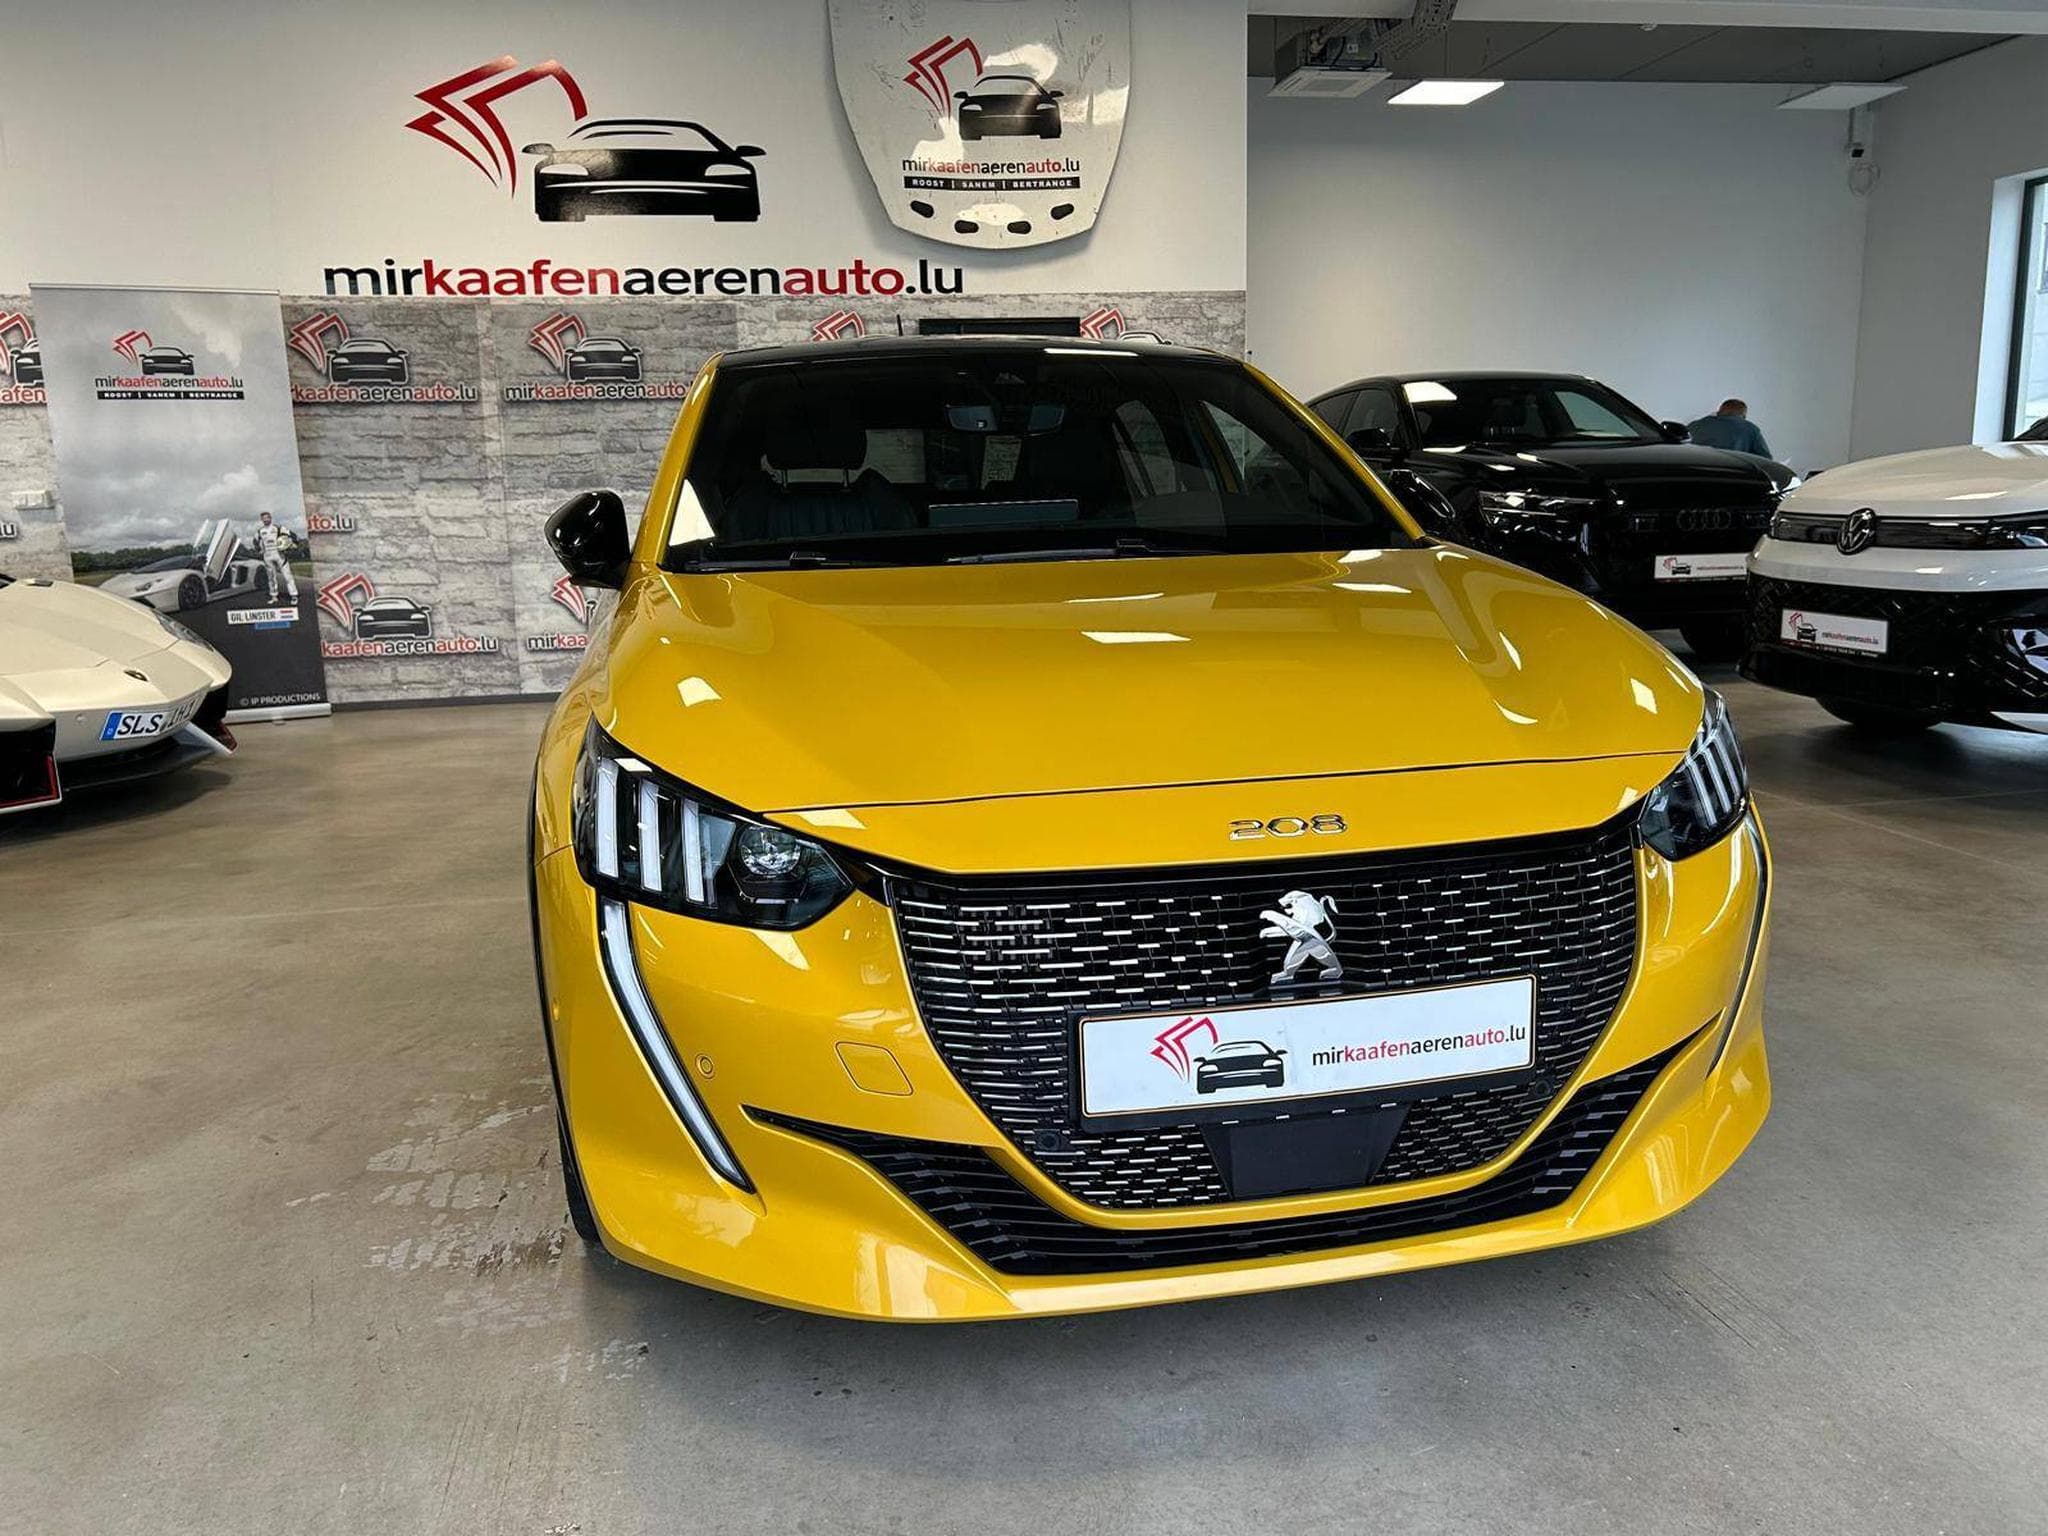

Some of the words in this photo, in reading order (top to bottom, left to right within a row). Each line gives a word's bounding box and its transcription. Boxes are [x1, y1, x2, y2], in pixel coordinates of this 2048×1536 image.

[902, 157, 1080, 175] mirkaafenaerenauto.lu
[912, 179, 945, 188] ROOST
[962, 181, 996, 189] SANEM
[1012, 179, 1073, 188] BERTRANGE
[324, 258, 964, 297] mirkaafenaerenauto.lu
[95, 375, 244, 389] mirkaafenaerenauto.lu
[290, 383, 477, 401] kaafenaerenauto.lu
[1229, 814, 1348, 841] 208
[1312, 1025, 1526, 1066] mirkaafenaerenauto.lu
